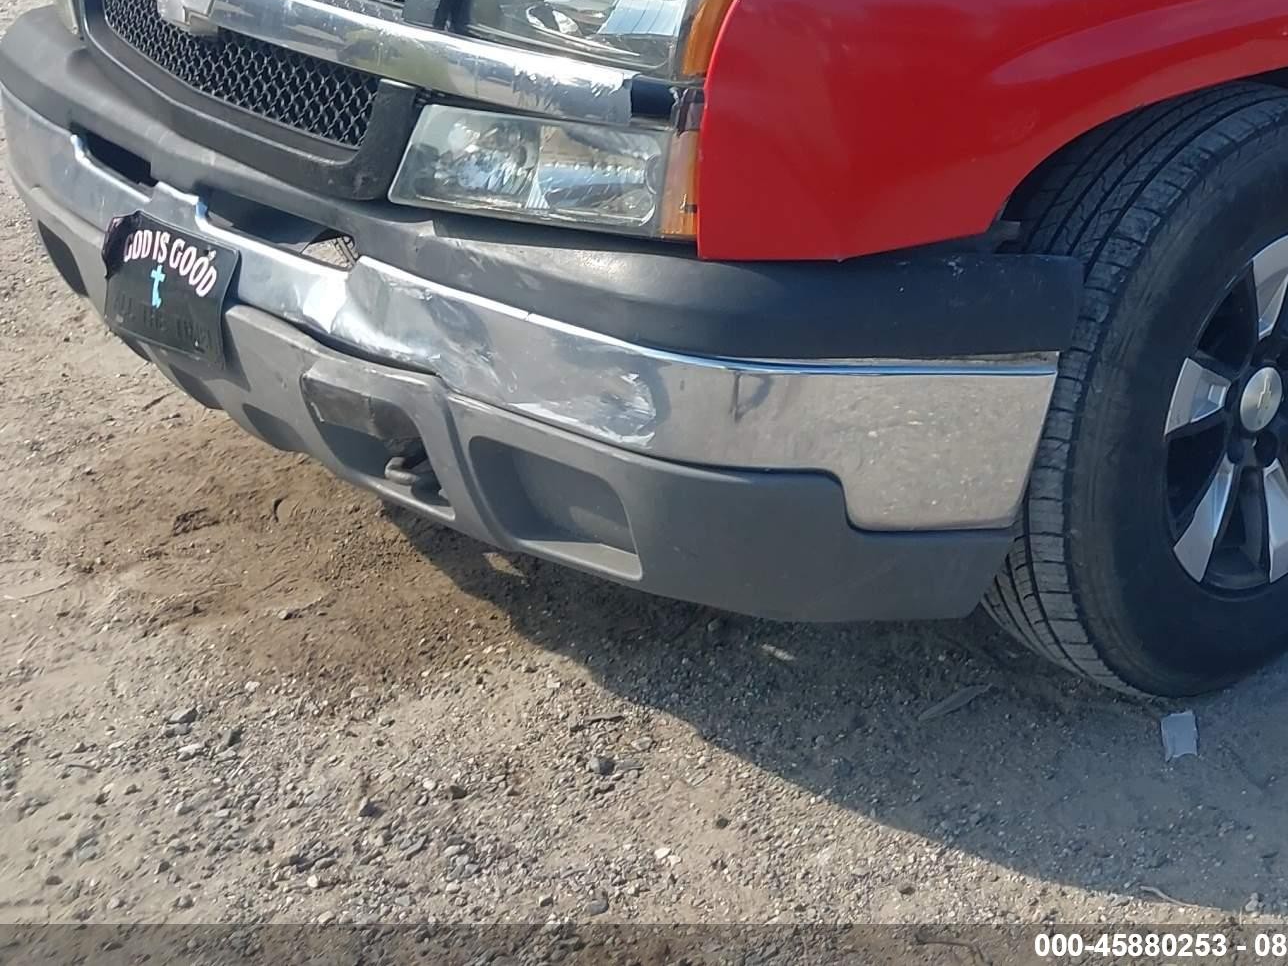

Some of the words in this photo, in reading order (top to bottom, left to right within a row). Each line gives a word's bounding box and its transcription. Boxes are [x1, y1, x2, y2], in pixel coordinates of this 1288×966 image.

[123, 230, 153, 263] GOD
[152, 230, 171, 264] IS
[169, 238, 218, 298] GOOD
